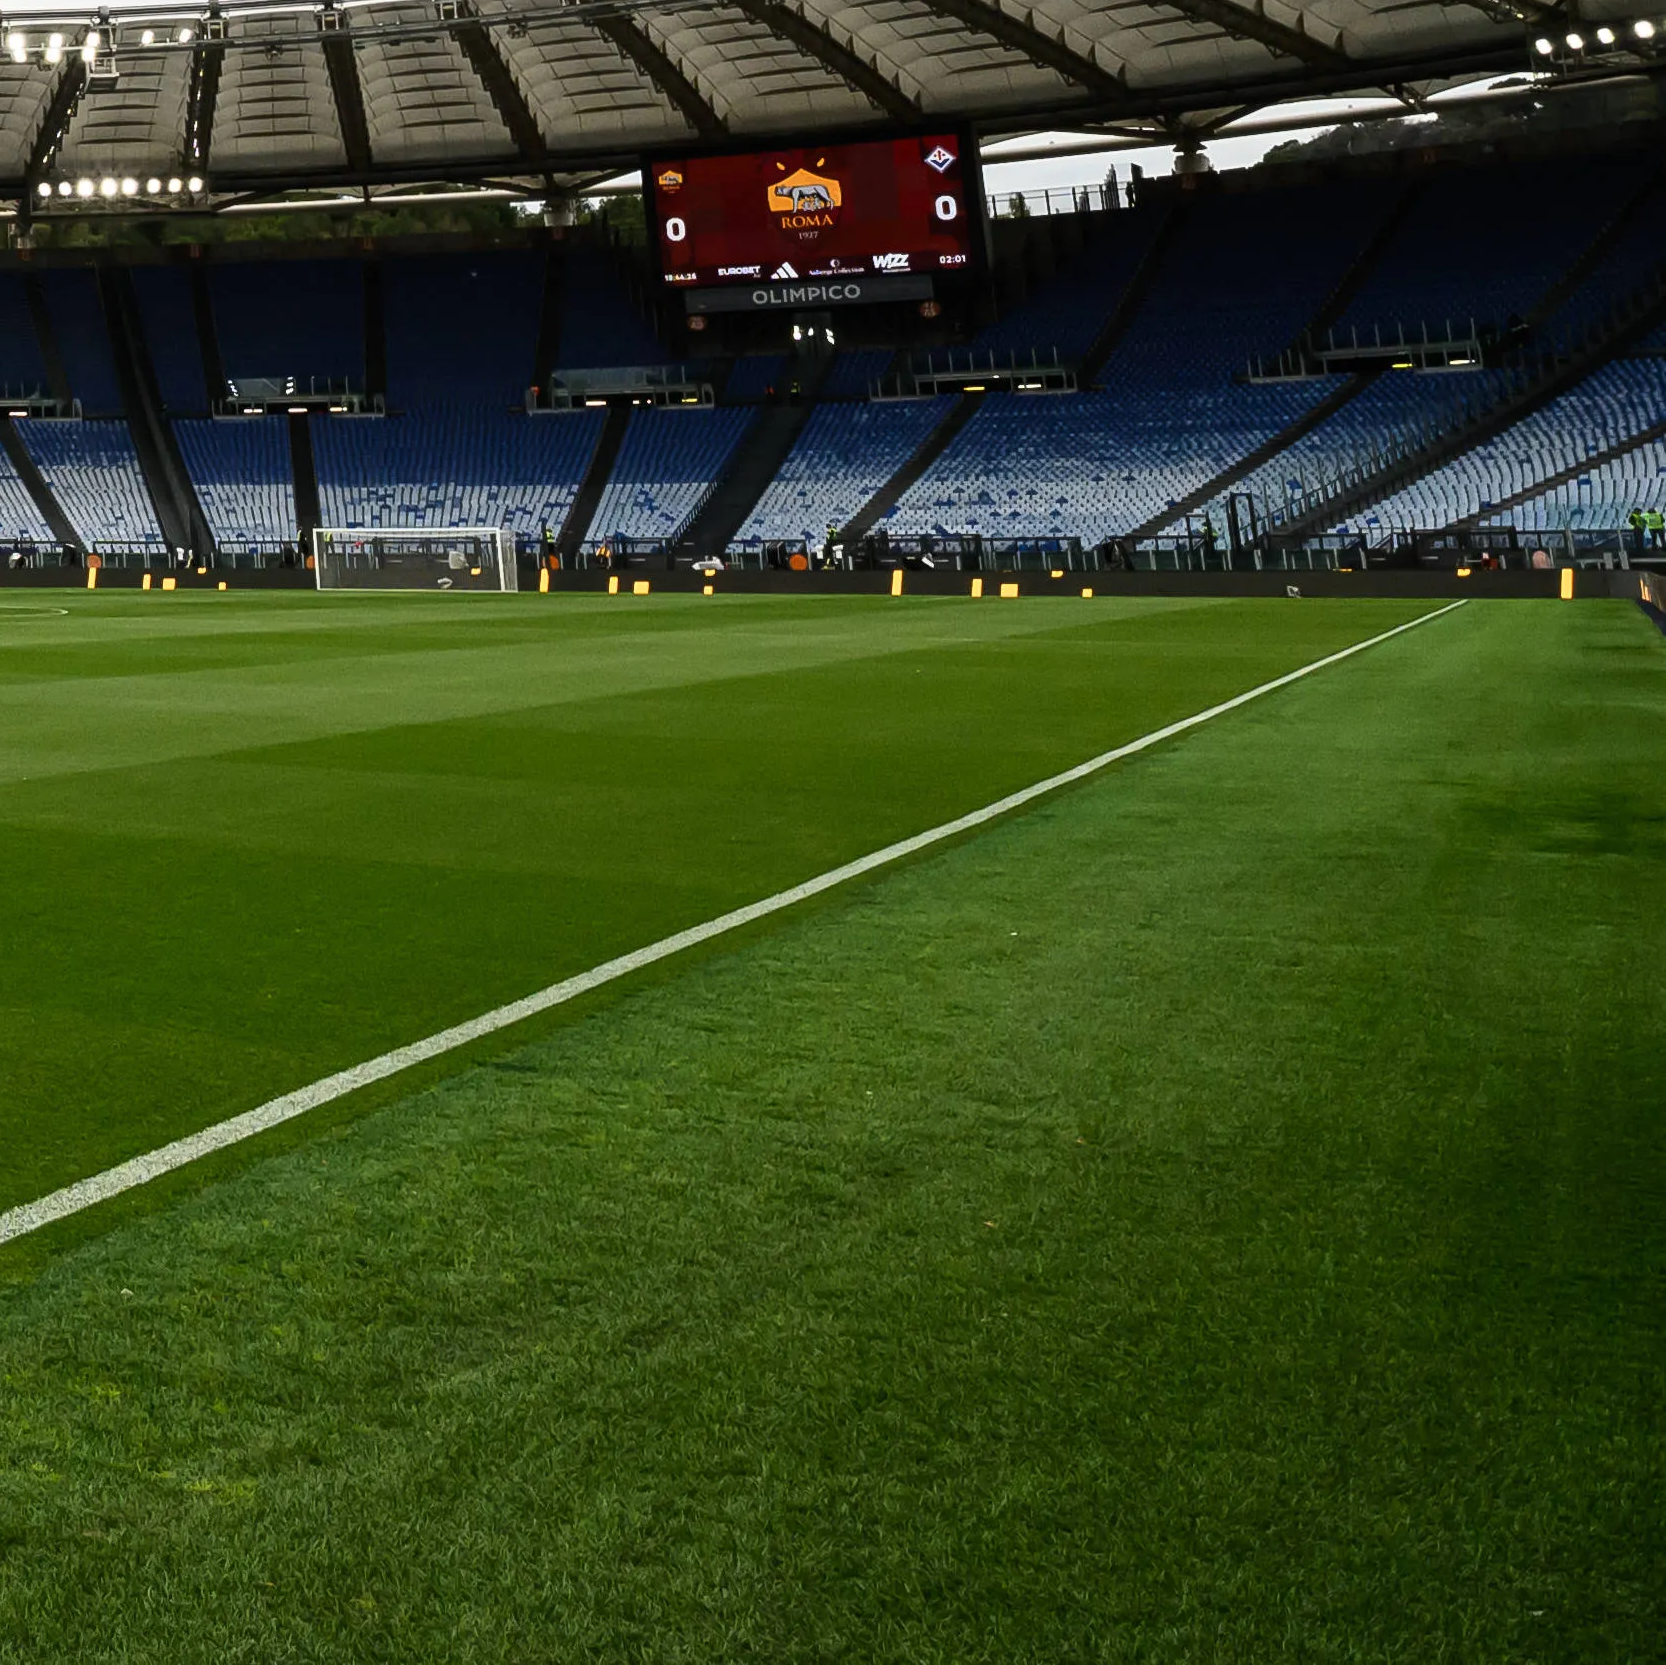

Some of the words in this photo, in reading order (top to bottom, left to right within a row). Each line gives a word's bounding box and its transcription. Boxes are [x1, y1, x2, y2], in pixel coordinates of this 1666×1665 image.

[935, 196, 957, 220] 0
[666, 217, 686, 242] 0
[781, 214, 833, 229] ROMA
[939, 255, 966, 264] 02:01
[717, 265, 761, 276] EUROBET
[752, 284, 861, 305] OLIMPICO
